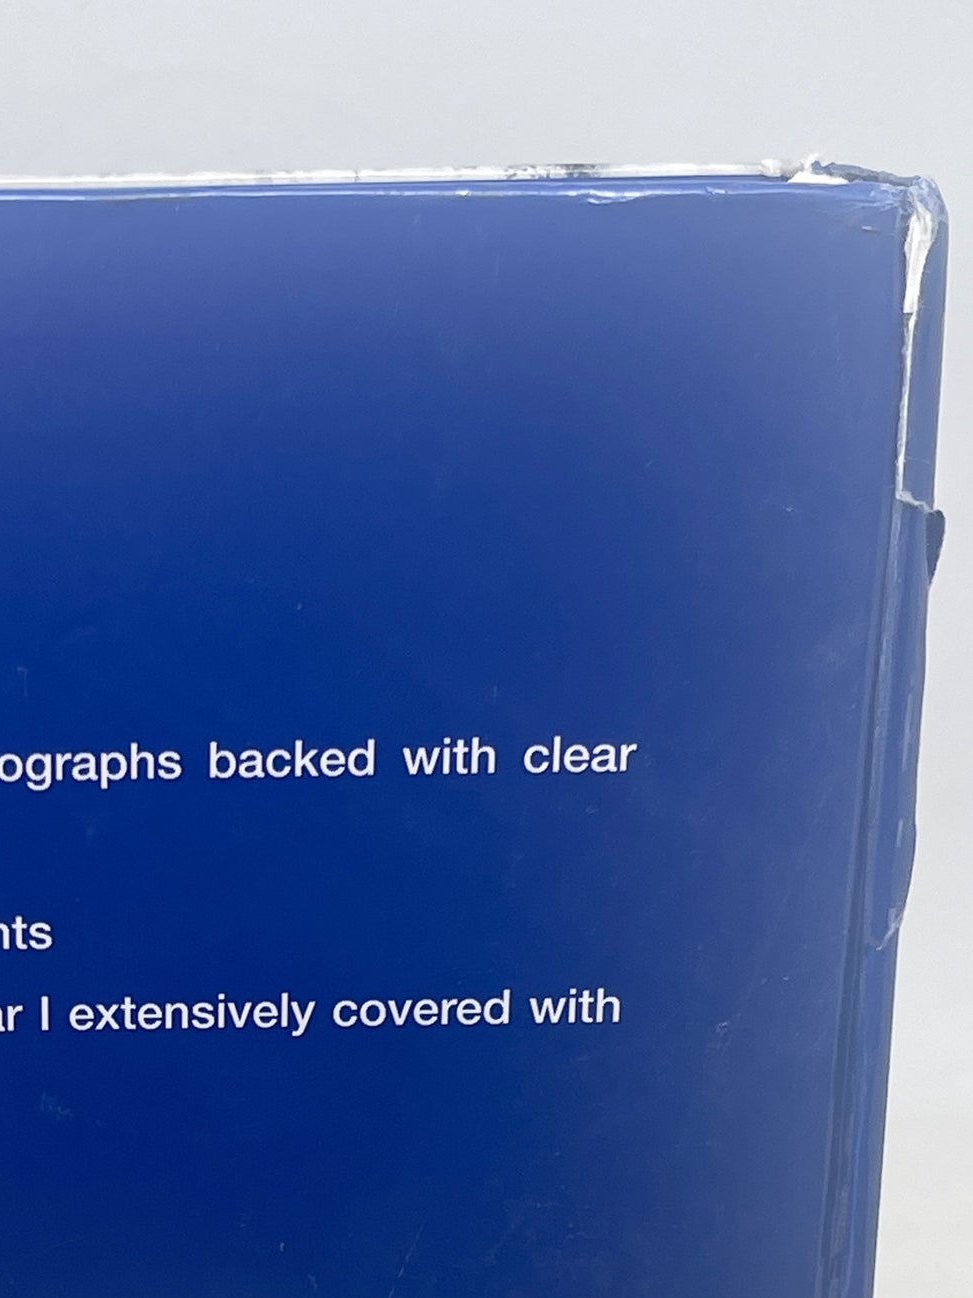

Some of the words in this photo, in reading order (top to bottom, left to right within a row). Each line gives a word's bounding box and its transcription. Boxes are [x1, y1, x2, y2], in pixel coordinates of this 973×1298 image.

[209, 738, 375, 779] backed
[402, 736, 496, 775] with
[523, 735, 638, 774] clear
[40, 995, 50, 1031] I
[69, 992, 316, 1037] extensively
[333, 989, 511, 1027] covered
[529, 987, 620, 1024] with
